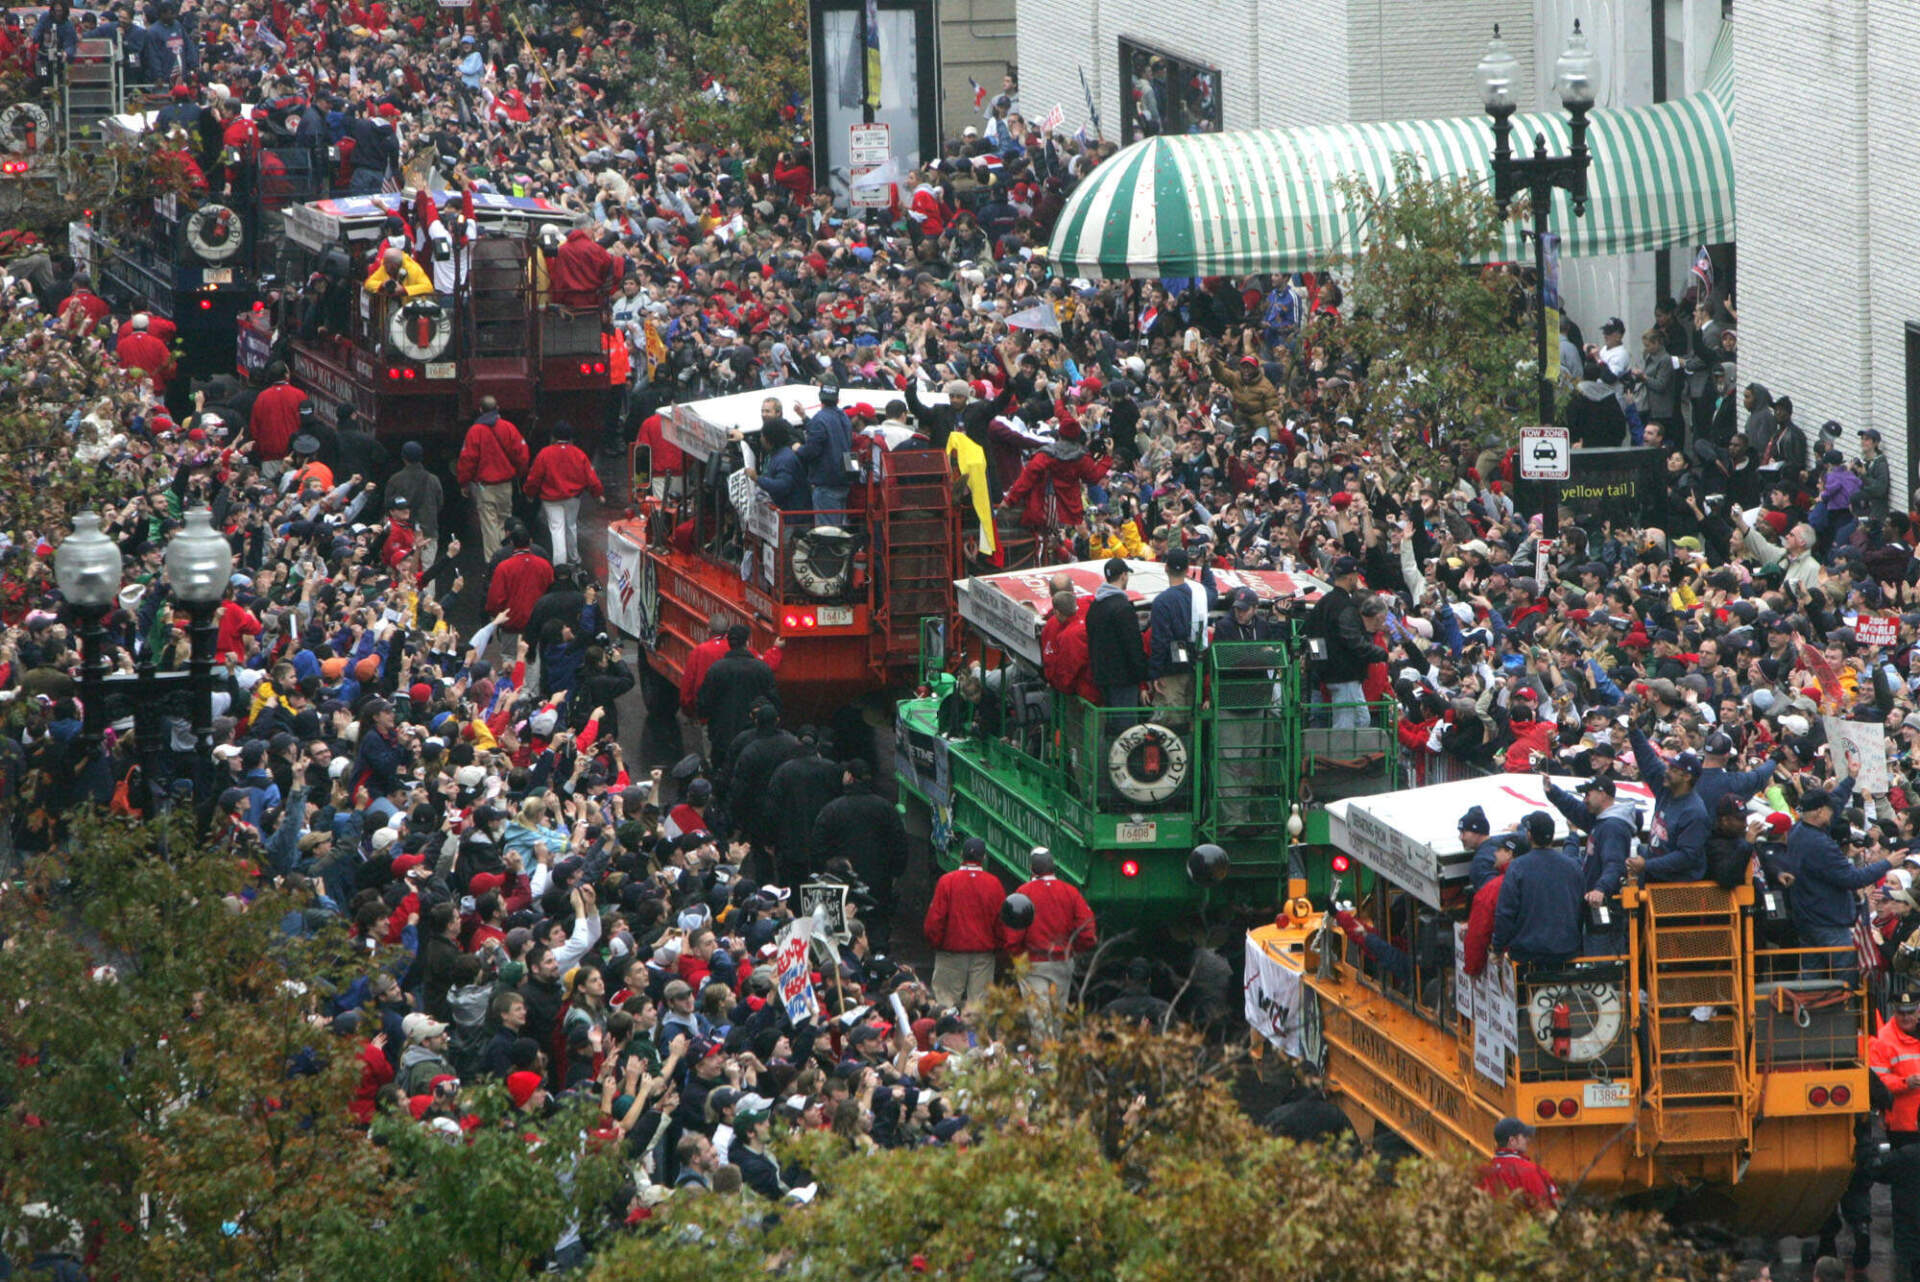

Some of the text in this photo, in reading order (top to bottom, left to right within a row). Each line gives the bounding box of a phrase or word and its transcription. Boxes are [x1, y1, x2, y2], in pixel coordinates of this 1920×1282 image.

[1524, 429, 1564, 437] TOW ZONE
[1561, 485, 1604, 501] yellow
[1607, 482, 1627, 497] tail
[1860, 623, 1896, 635] WORLD
[1855, 632, 1897, 645] CHAMPS
